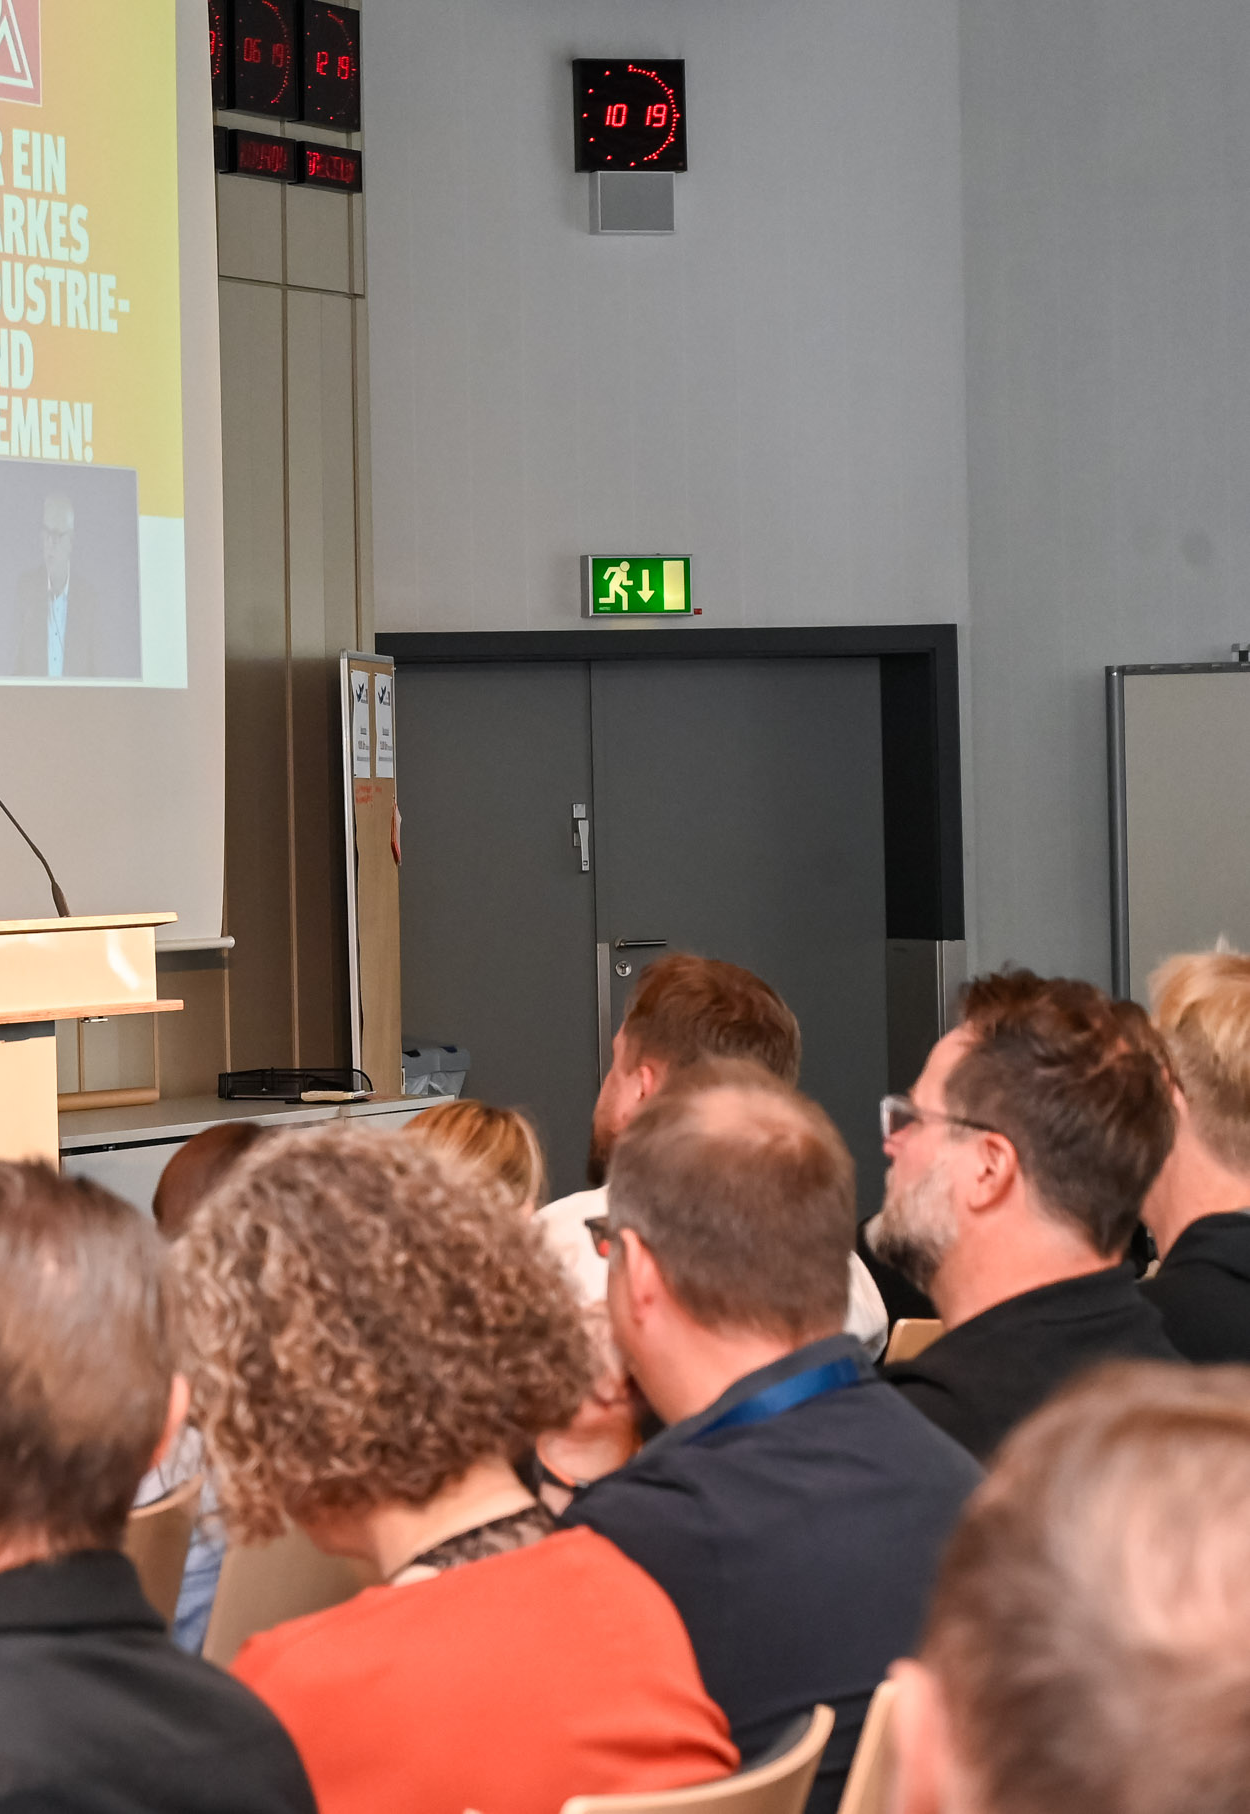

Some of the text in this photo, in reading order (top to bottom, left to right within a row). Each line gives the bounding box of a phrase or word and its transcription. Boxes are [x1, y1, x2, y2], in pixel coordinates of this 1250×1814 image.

[605, 103, 668, 127] 10 19
[12, 127, 67, 196] EIN
